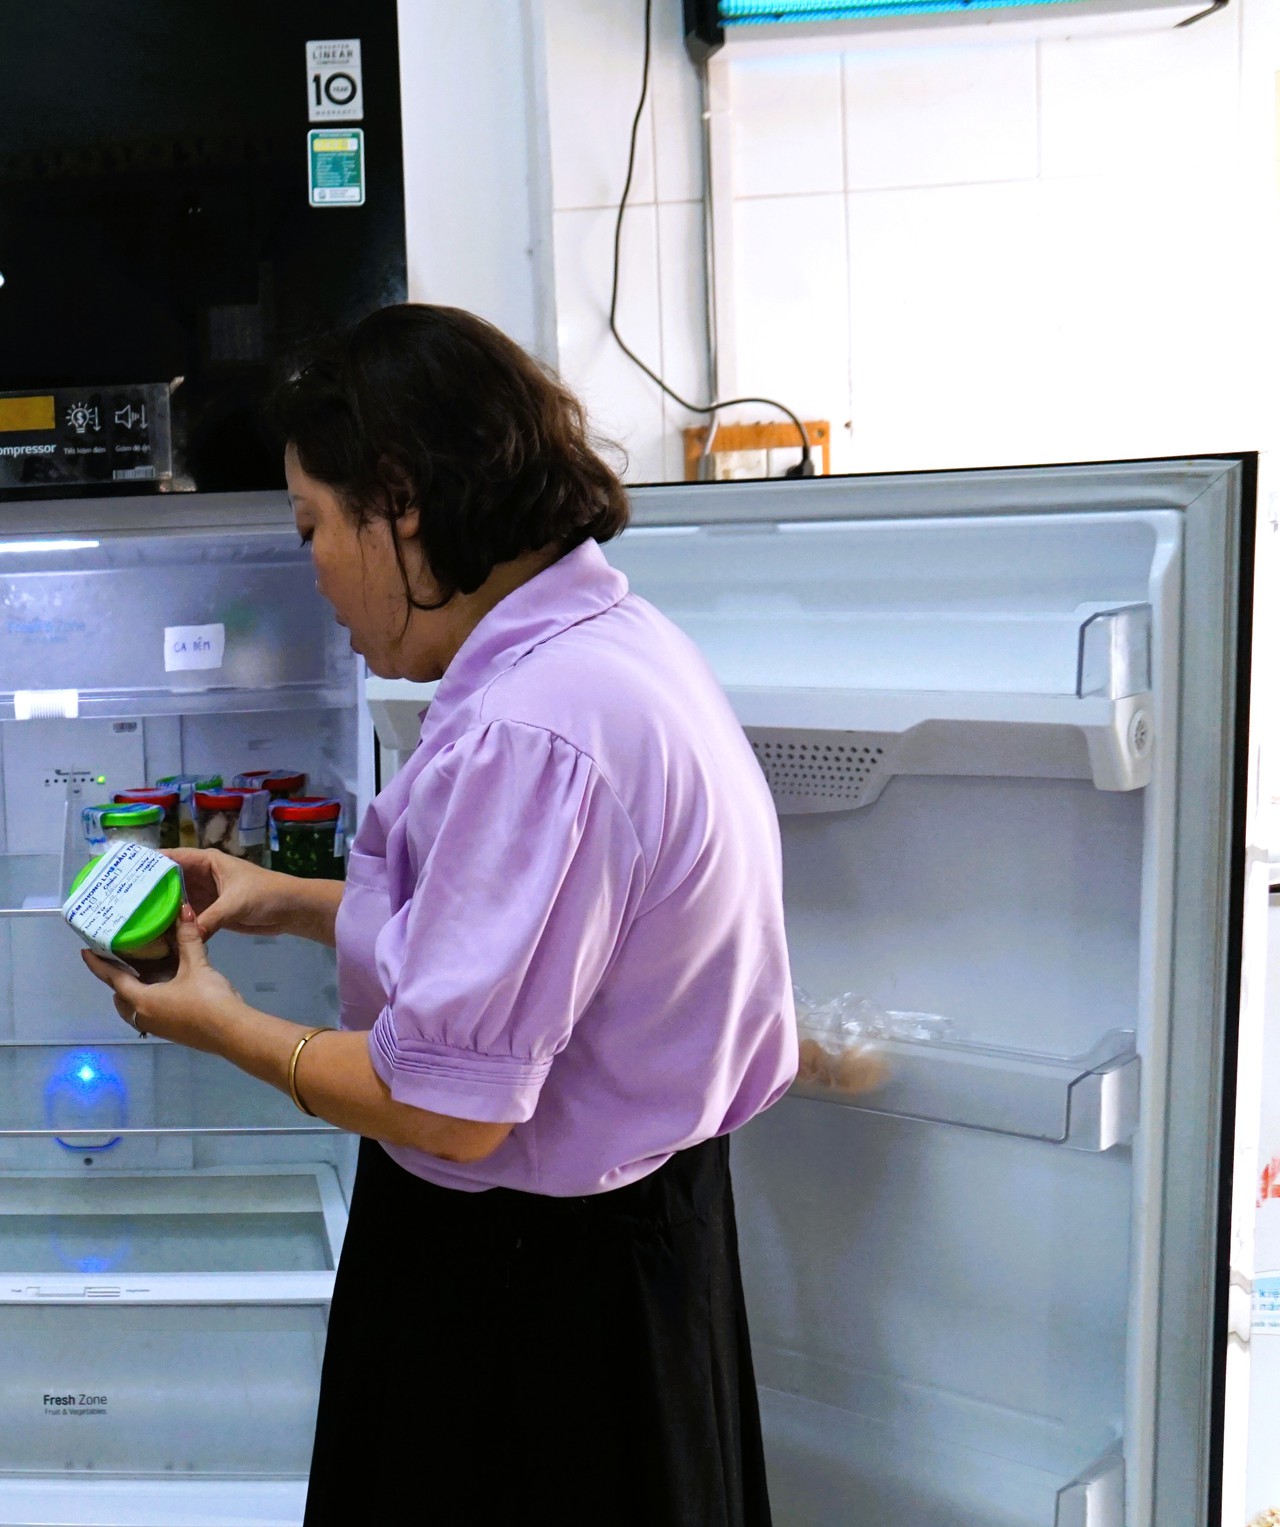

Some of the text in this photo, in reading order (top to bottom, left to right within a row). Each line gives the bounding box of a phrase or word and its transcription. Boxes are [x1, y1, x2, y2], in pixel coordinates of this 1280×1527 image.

[312, 50, 354, 60] LINEAR
[313, 72, 357, 106] 10
[174, 641, 187, 653] CA
[81, 882, 102, 904] PHONG
[43, 1394, 107, 1405] Fresh Zone
[69, 1408, 107, 1416] Vegetables
